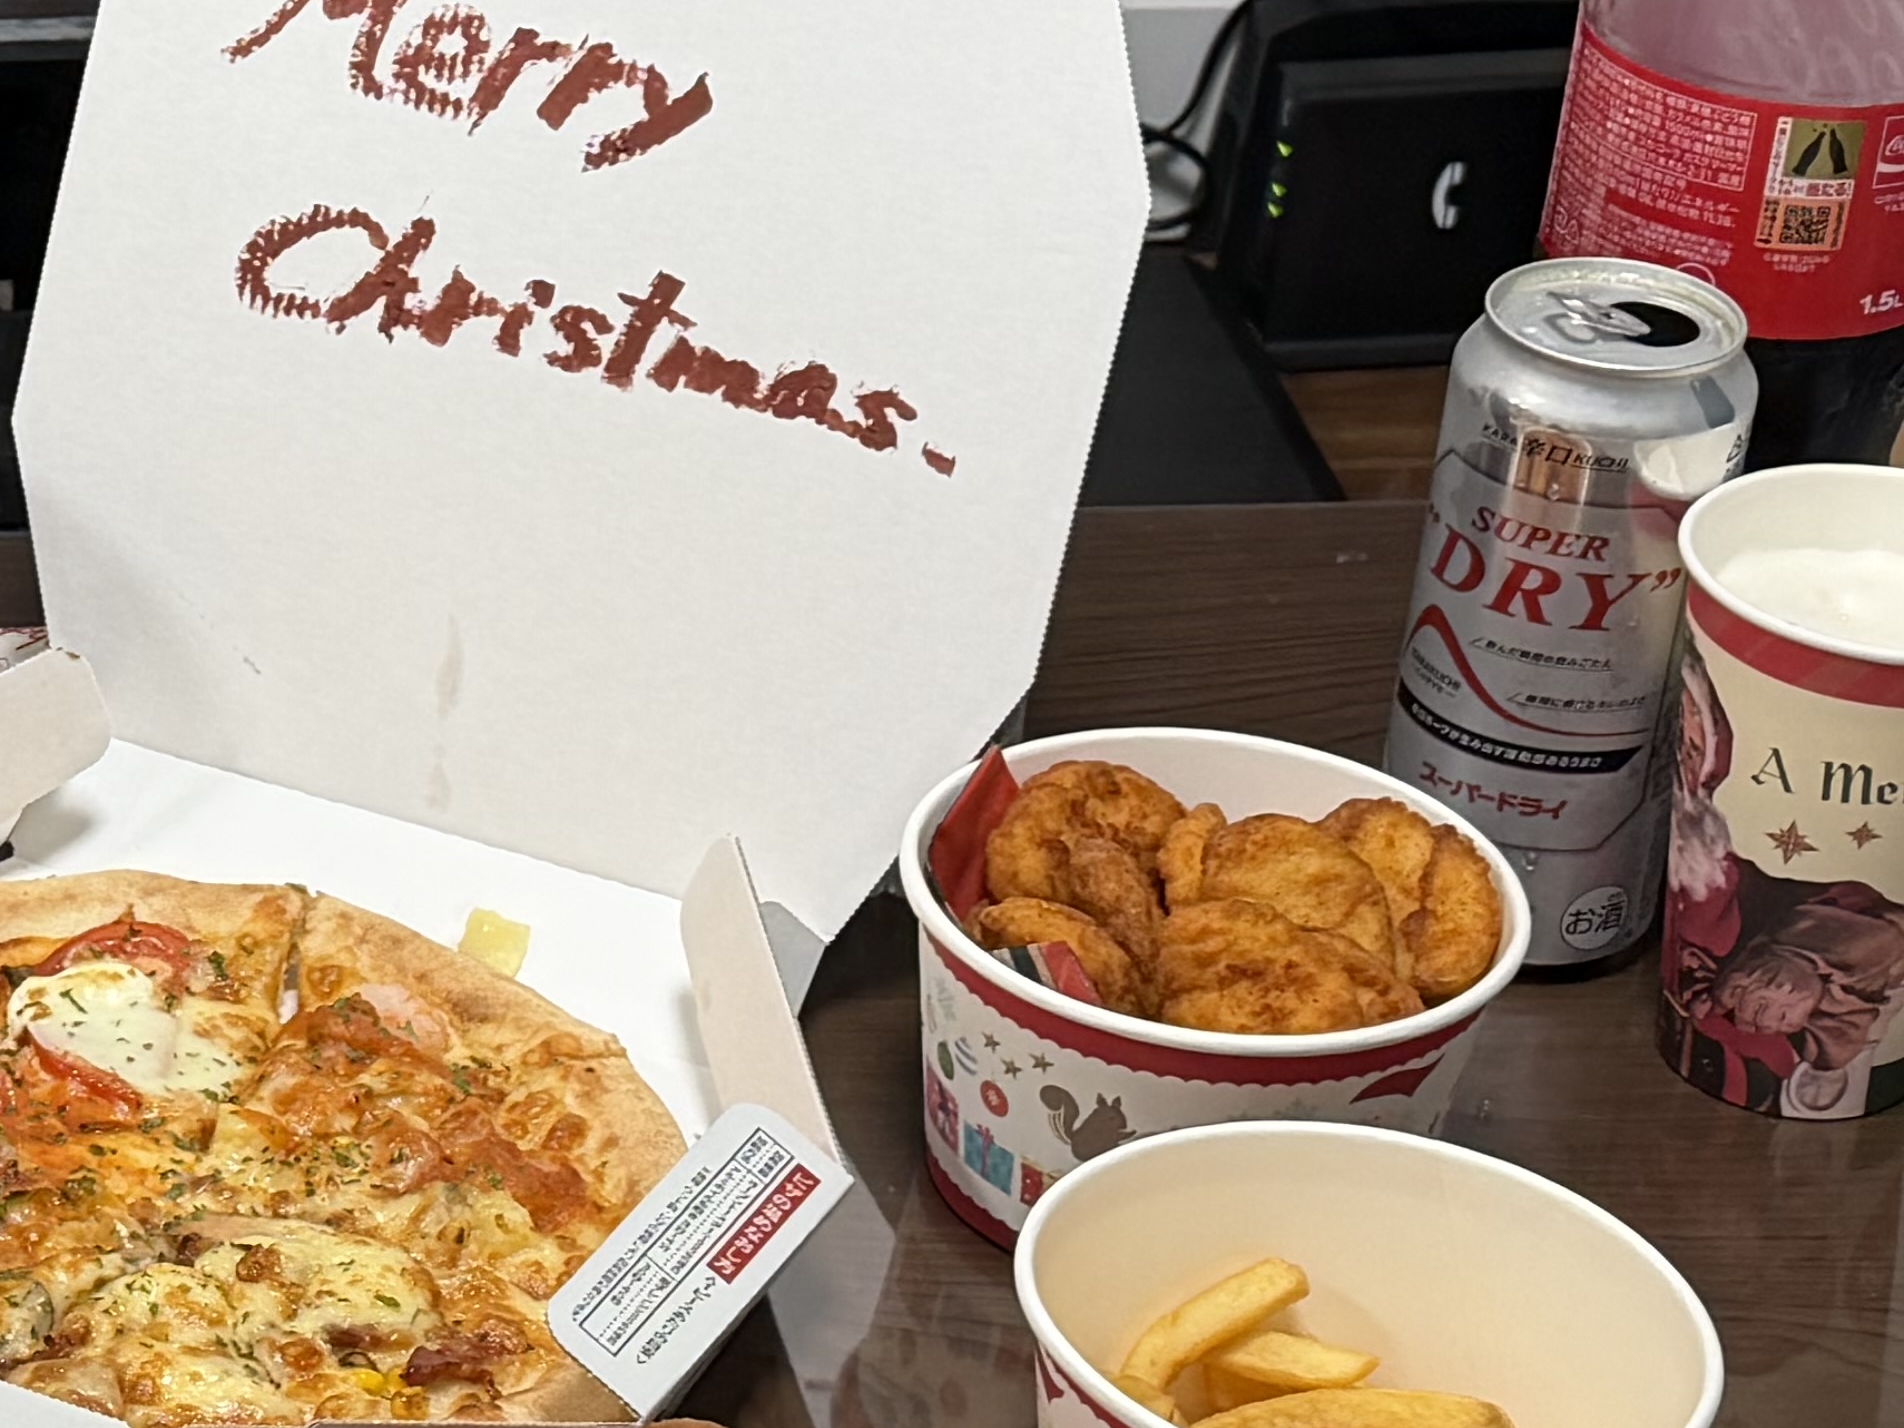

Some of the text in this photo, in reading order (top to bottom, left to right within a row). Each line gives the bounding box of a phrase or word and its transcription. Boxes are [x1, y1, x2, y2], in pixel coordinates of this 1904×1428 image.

[1472, 506, 1612, 562] SUPER
[1418, 760, 1568, 820] スーパードライ
[1750, 746, 1904, 805] A Me
[1565, 900, 1625, 935] お酒
[710, 1171, 816, 1277] ピザの温めなおし方
